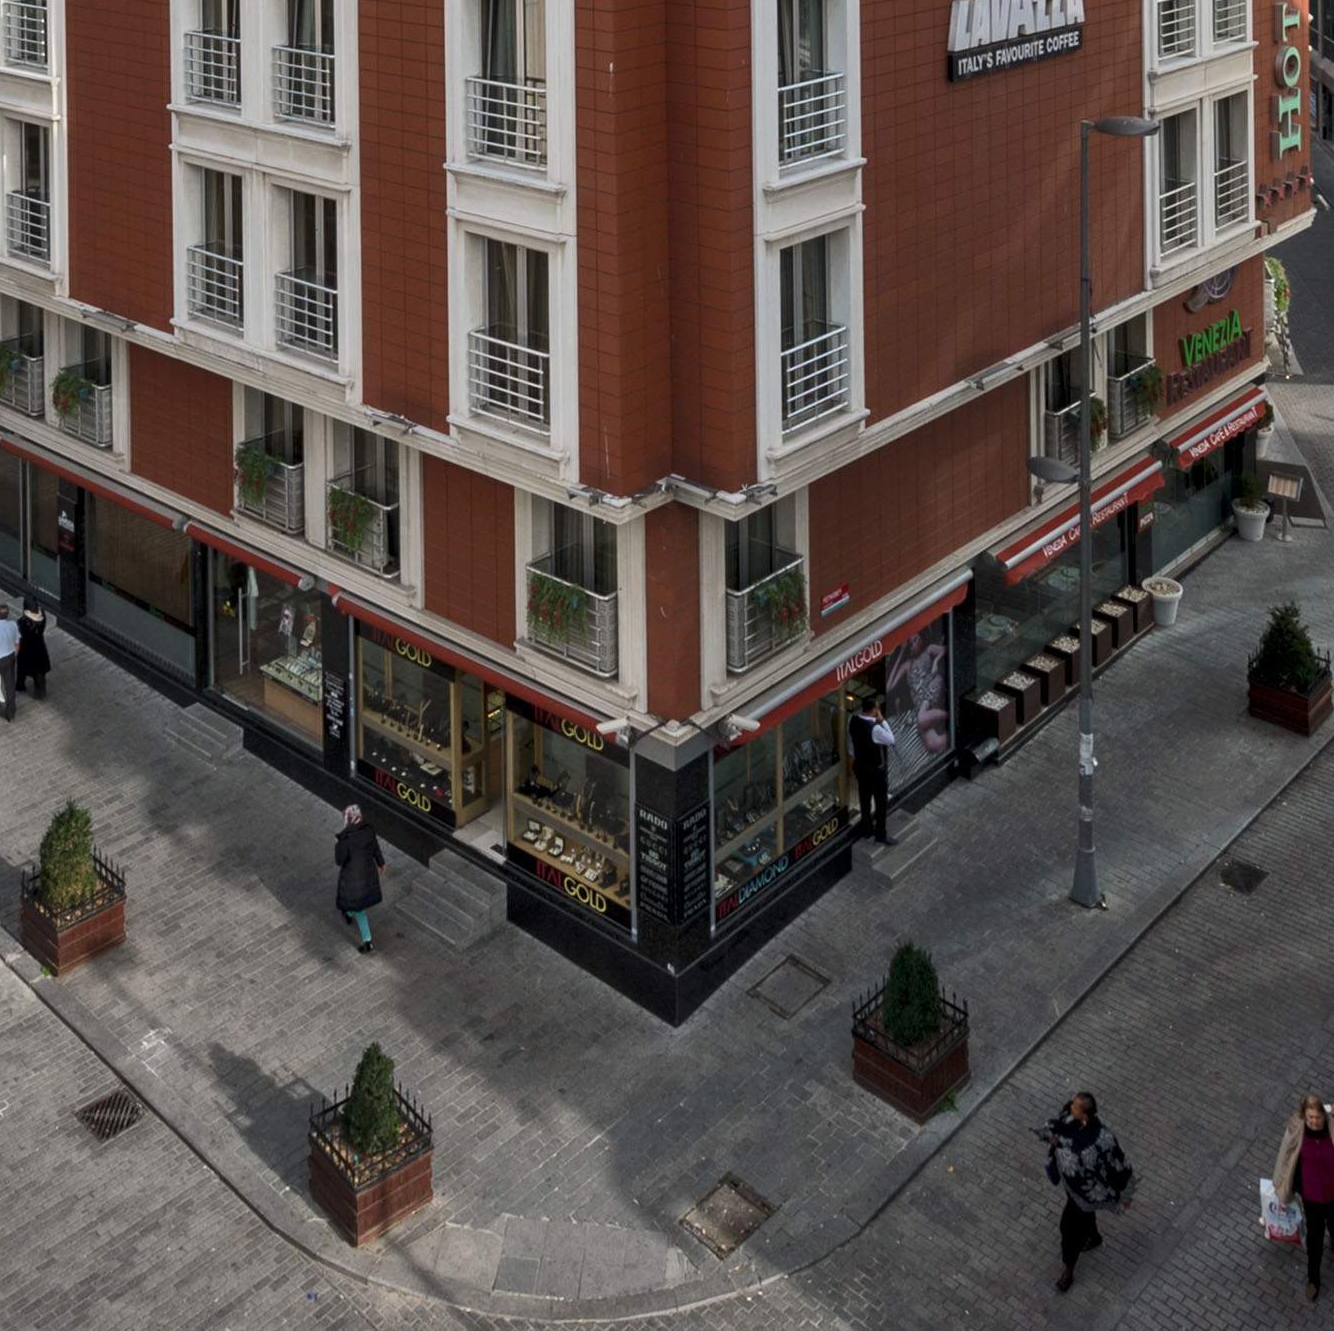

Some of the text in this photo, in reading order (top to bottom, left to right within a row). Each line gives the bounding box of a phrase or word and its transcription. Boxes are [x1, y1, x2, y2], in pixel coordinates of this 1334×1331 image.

[958, 31, 1079, 76] ITALY'S FAVOURITE COFFEE
[1180, 309, 1243, 367] VENEZIA
[836, 640, 883, 682] ITALGOLD
[374, 769, 432, 813] ITALGOLD
[639, 809, 667, 830] RADO
[535, 860, 607, 913] ITALGOLD
